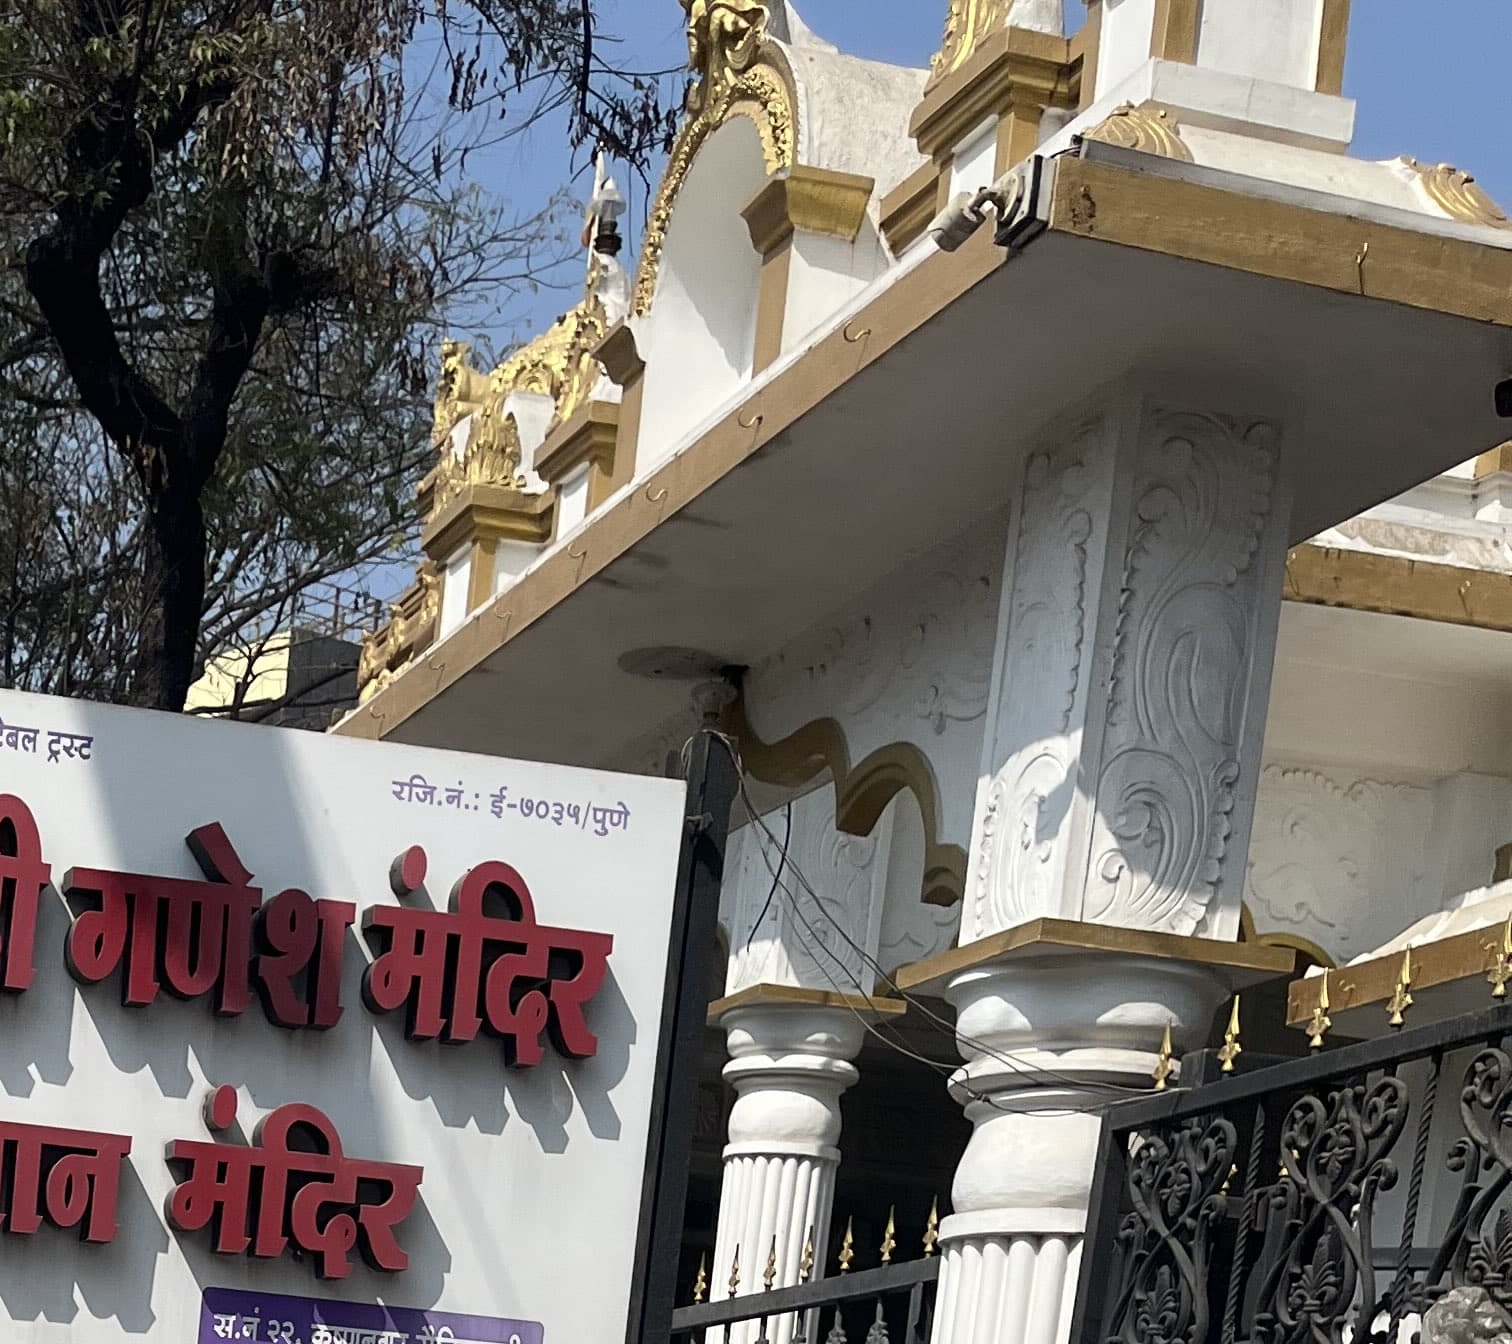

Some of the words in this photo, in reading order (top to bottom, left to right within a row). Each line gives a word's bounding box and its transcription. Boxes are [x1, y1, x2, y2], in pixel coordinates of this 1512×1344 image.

[47, 730, 94, 763] ट्रस्ट
[63, 820, 358, 1031] गणेश
[361, 844, 615, 1069] मंदिर
[163, 1083, 425, 1280] मंदिर
